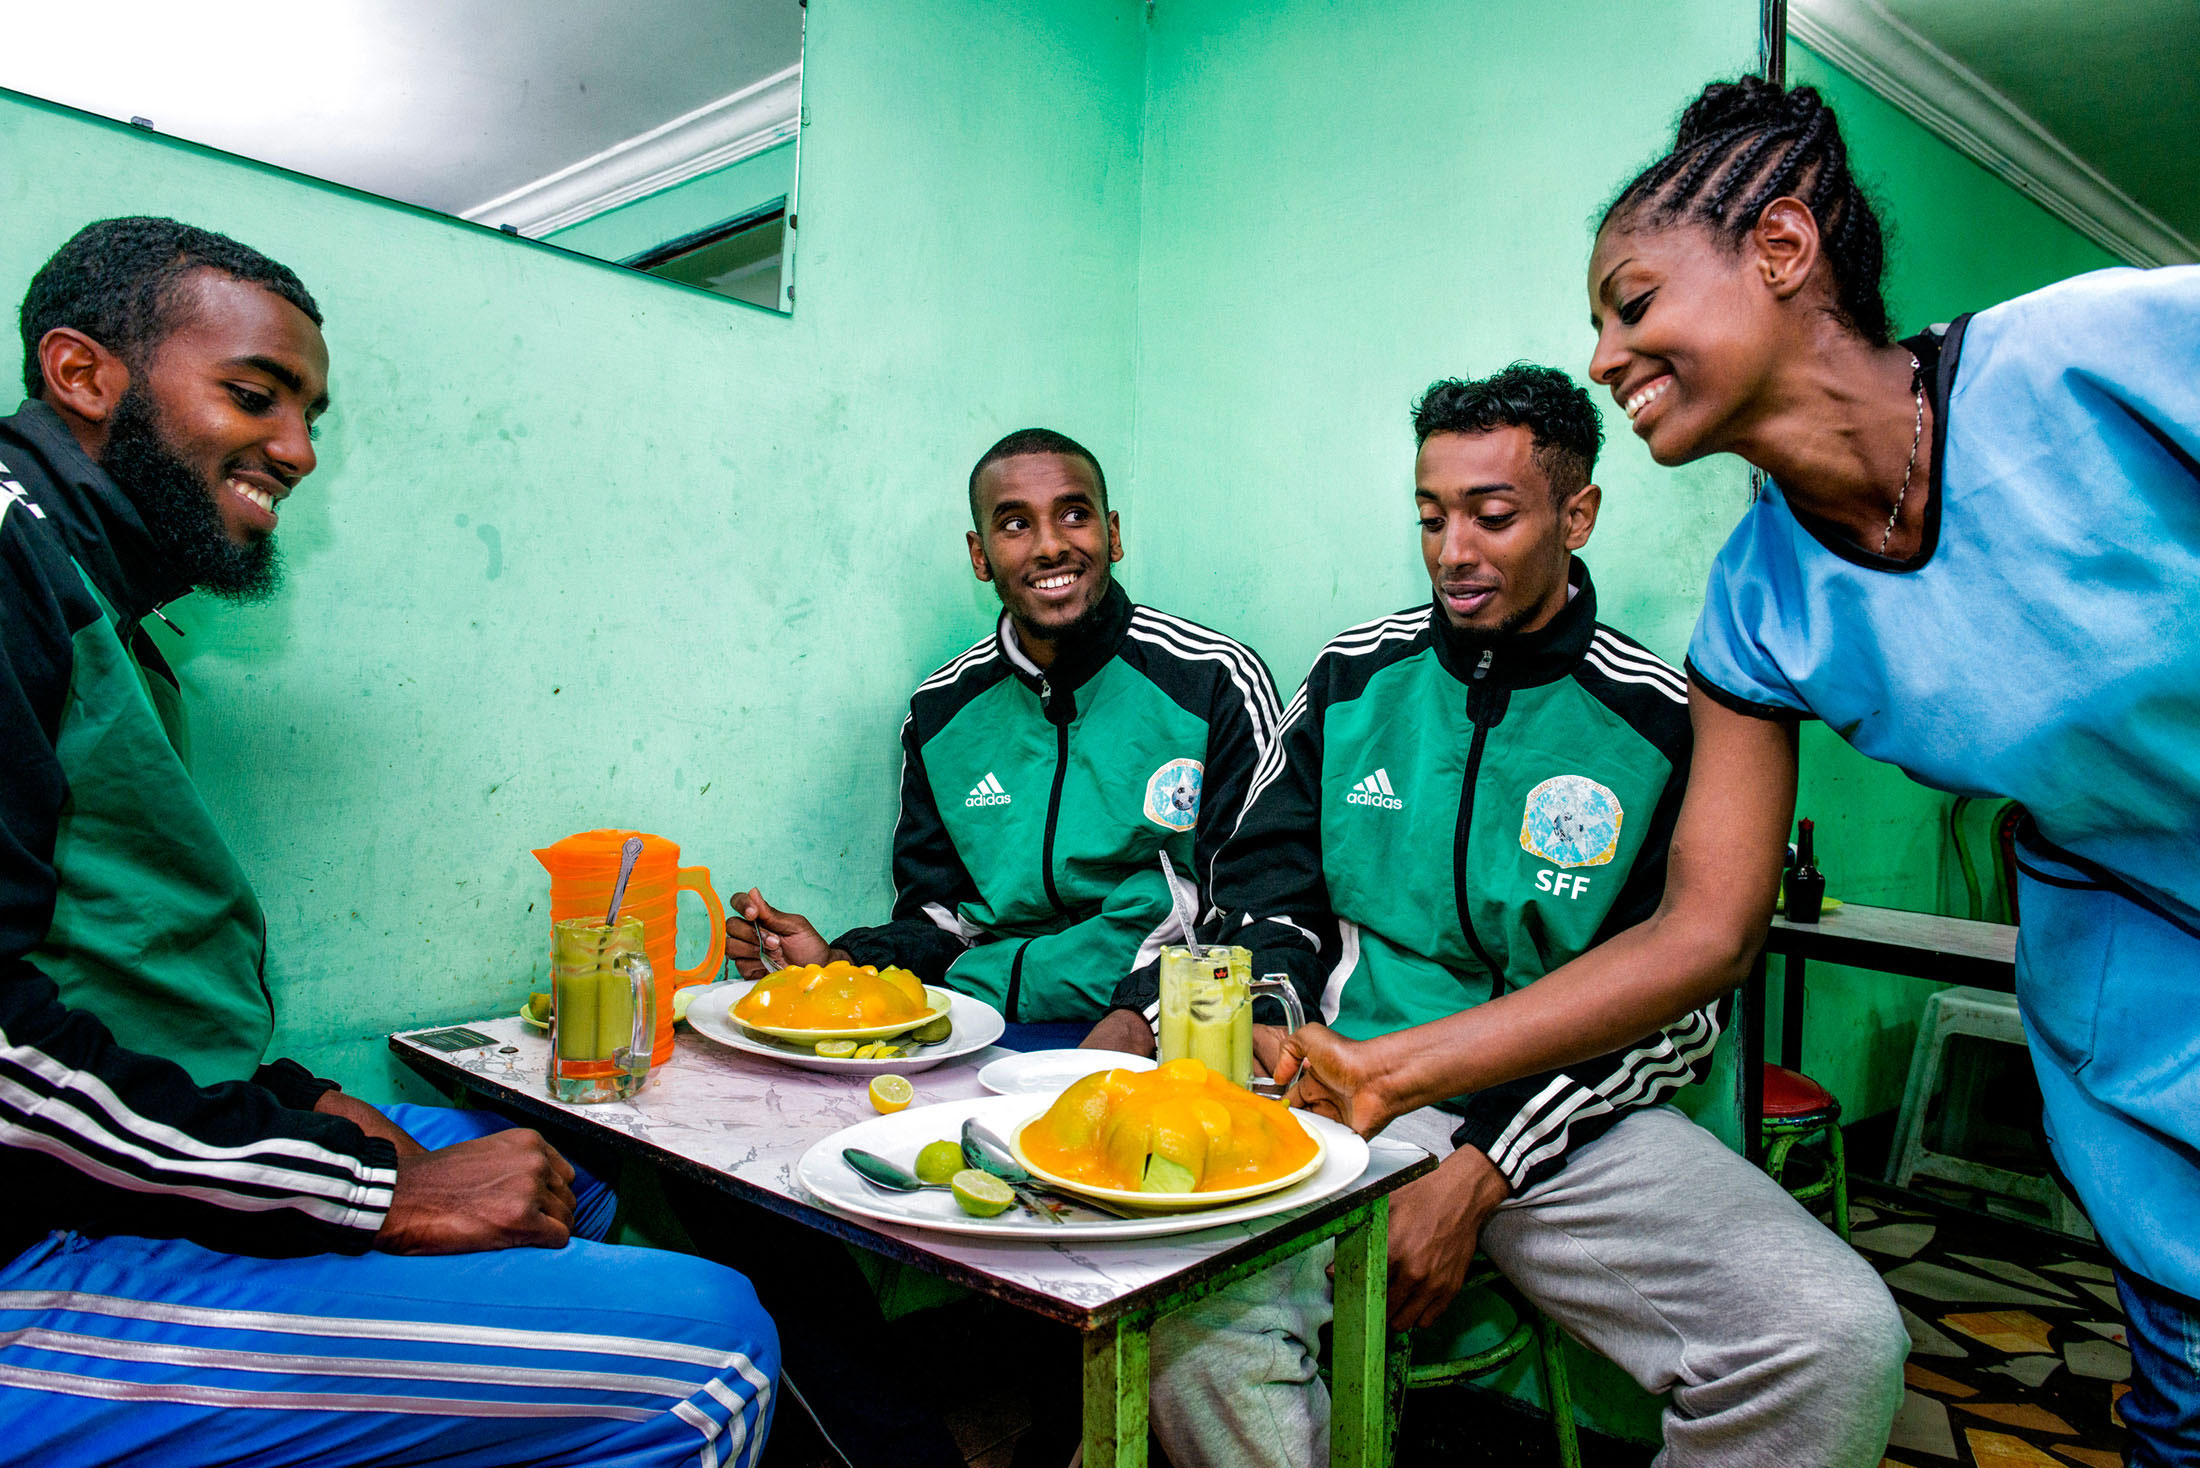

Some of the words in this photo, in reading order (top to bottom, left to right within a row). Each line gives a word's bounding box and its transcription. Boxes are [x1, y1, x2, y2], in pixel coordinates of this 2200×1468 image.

[965, 793, 1012, 807] adidas
[1346, 790, 1403, 810] adidas
[1534, 869, 1591, 900] SFF
